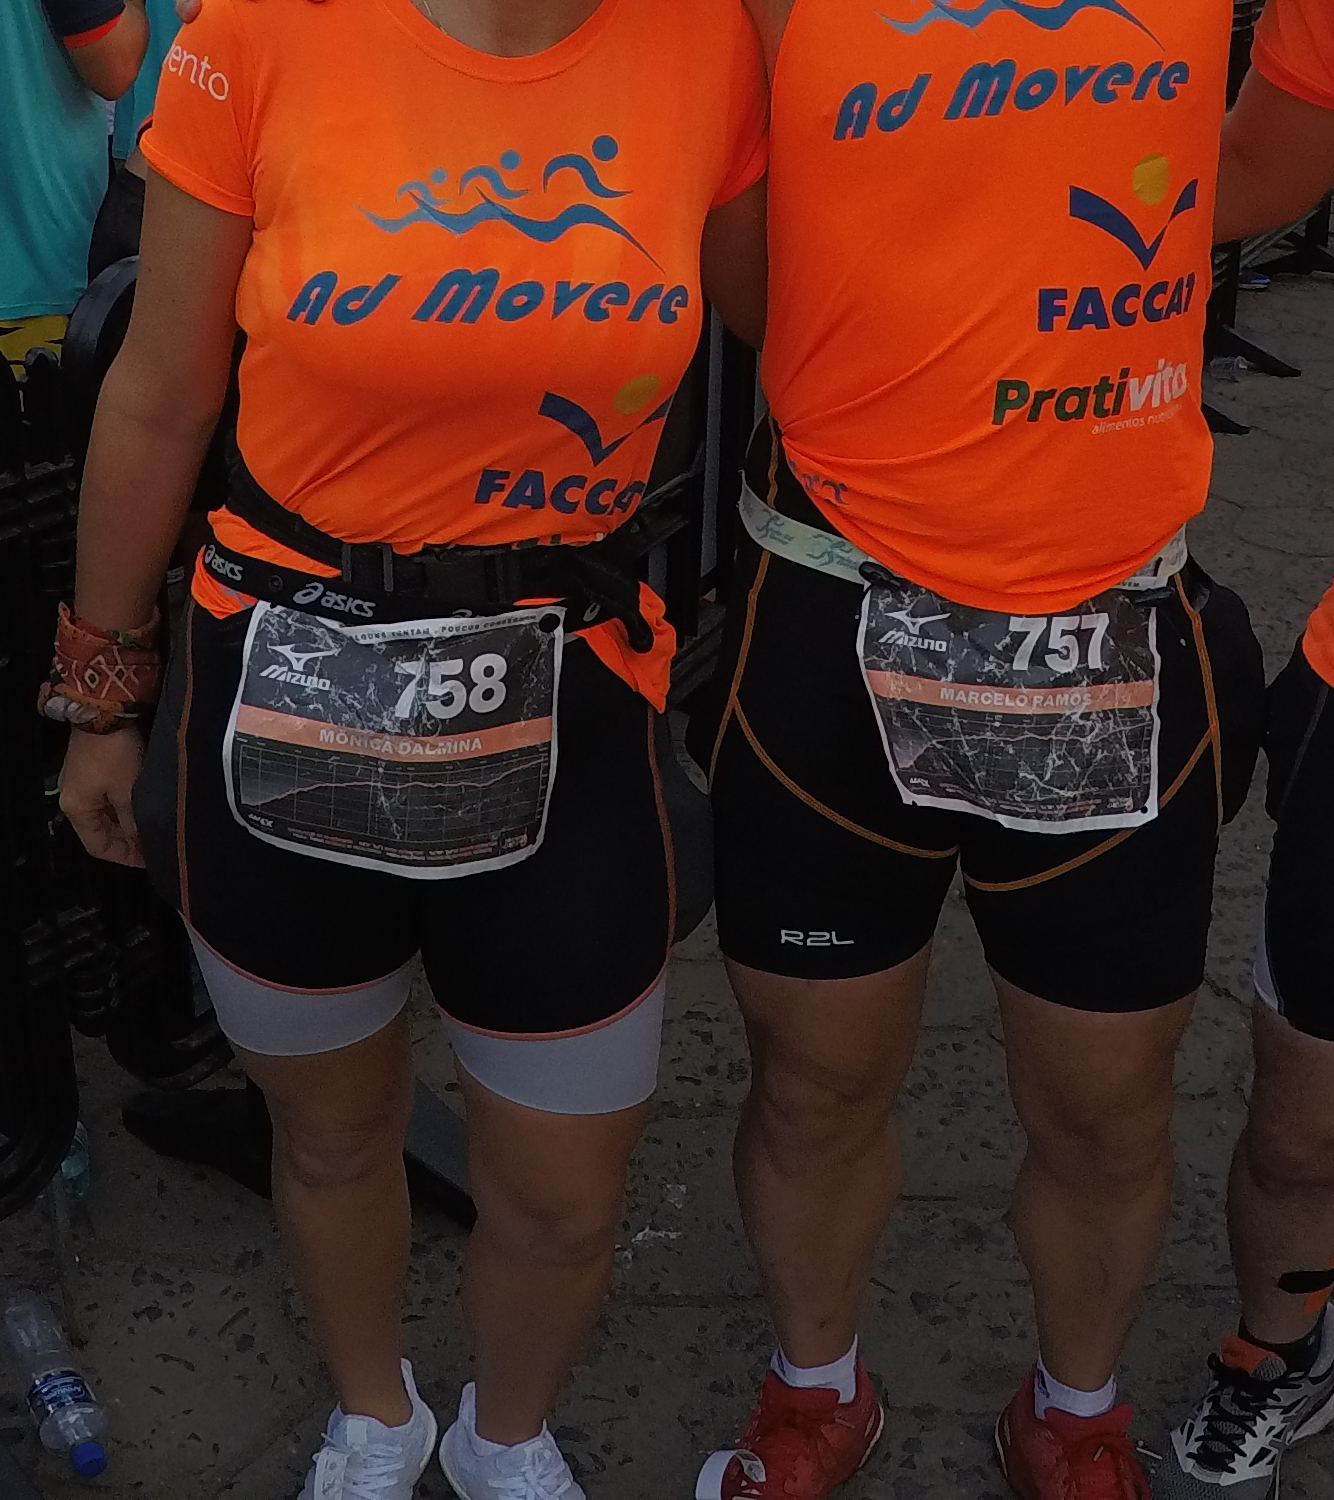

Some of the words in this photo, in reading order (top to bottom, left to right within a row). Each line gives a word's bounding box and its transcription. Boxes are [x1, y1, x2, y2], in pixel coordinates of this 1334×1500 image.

[163, 44, 230, 102] ento
[833, 73, 931, 142] Ad
[942, 57, 1190, 121] Movere
[286, 269, 402, 327] Ad
[411, 267, 689, 326] Movere
[1037, 271, 1196, 332] FACCAT
[1092, 415, 1146, 435] alimentos
[354, 631, 387, 642] LGUNS
[878, 630, 948, 653] MIZUNO
[1008, 612, 1110, 673] 757
[394, 653, 508, 720] 758
[940, 686, 1029, 708] MARCELO
[1032, 690, 1092, 708] RAMOS
[397, 737, 482, 757] DALMINA
[780, 928, 855, 946] R2L
